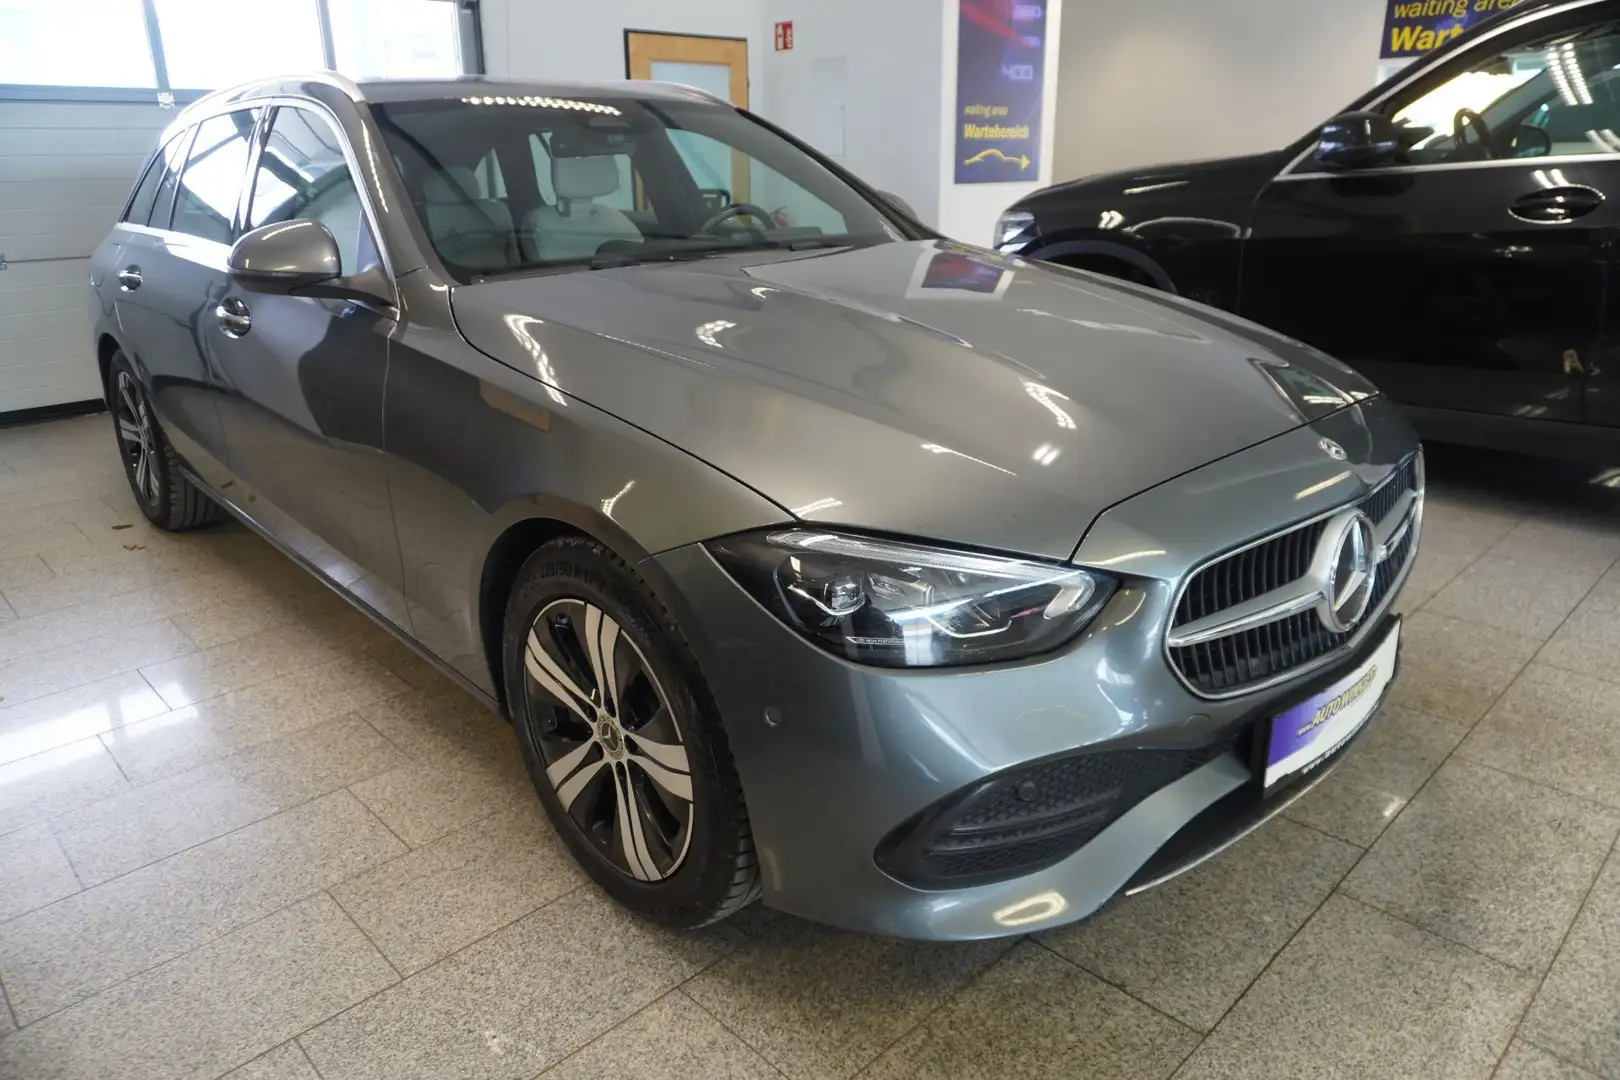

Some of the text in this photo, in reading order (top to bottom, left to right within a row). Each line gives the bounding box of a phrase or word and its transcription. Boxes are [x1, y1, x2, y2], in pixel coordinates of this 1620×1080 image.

[1394, 0, 1468, 18] waiting
[964, 104, 1008, 118] waiting area
[964, 123, 1029, 140] Wartebereich
